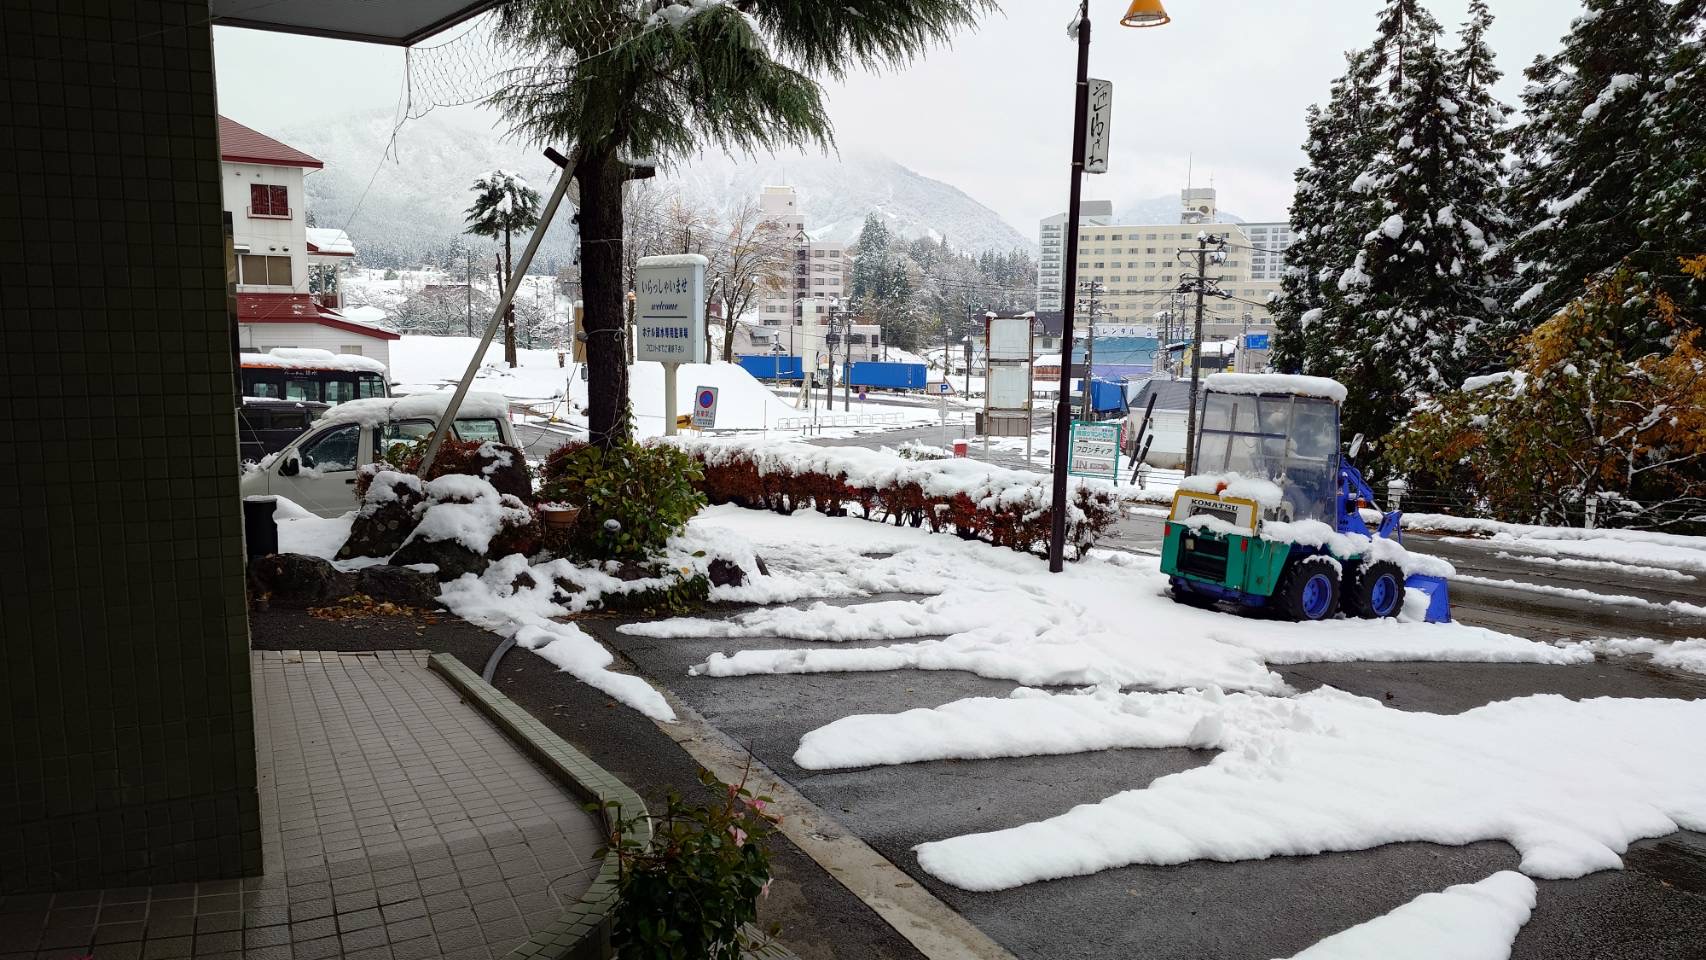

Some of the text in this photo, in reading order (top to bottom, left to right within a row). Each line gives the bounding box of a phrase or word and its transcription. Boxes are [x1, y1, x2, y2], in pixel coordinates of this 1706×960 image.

[641, 278, 687, 294] いらっしゃいませ
[651, 301, 678, 311] welcome
[1102, 327, 1134, 335] レンタル
[940, 384, 948, 392] P
[1075, 445, 1113, 455] フロンティア
[1076, 459, 1088, 469] IN
[1191, 498, 1239, 511] KOMATSU
